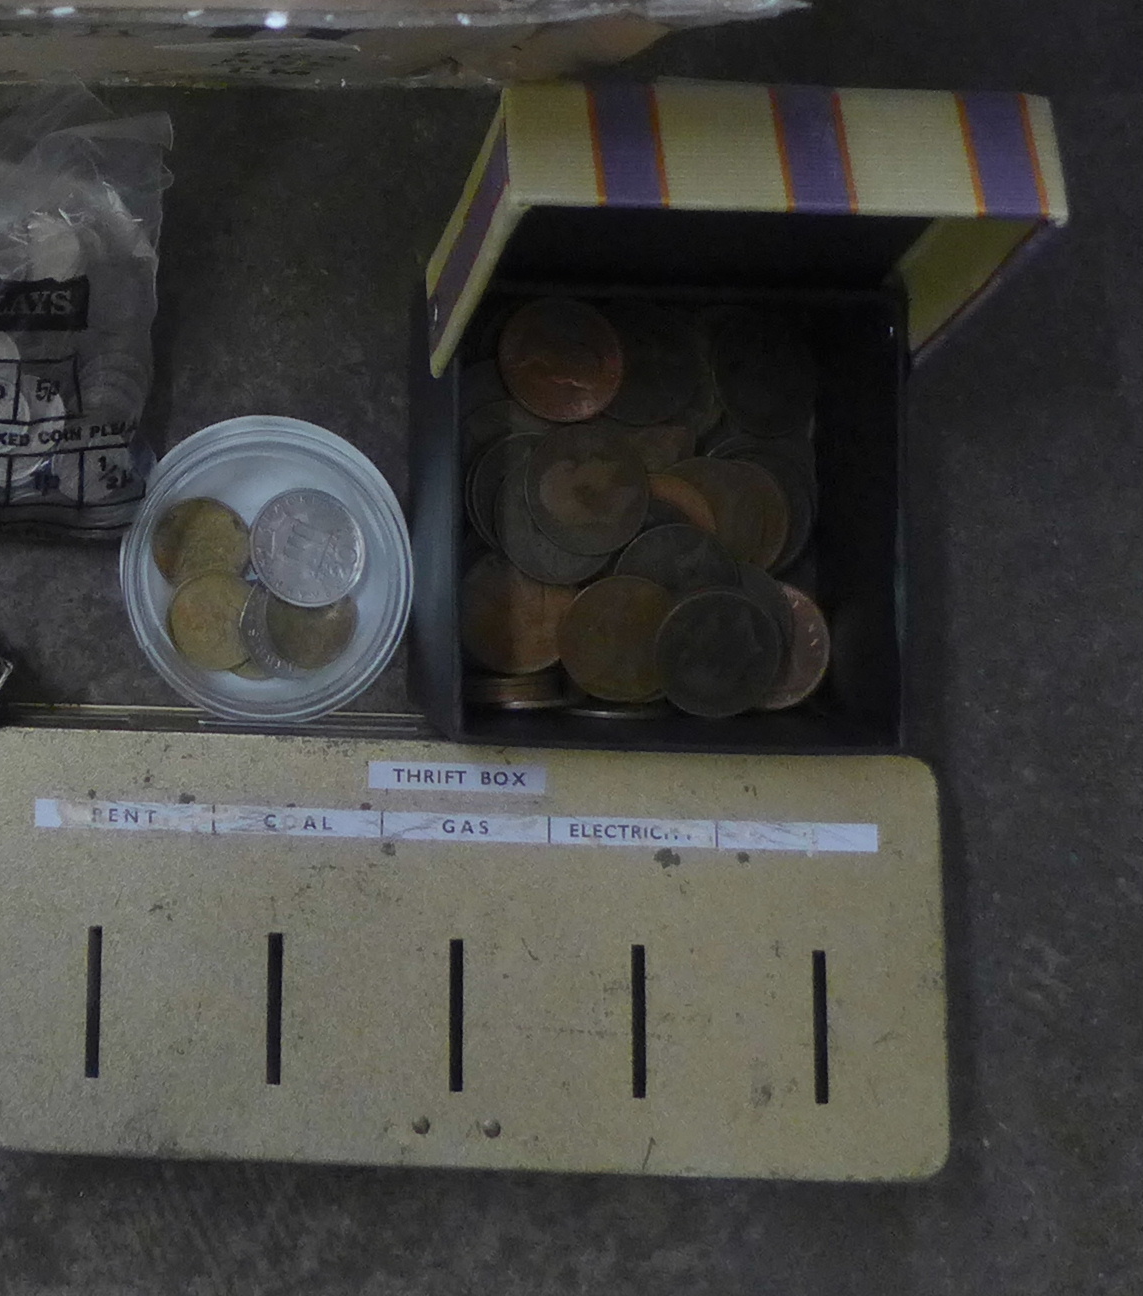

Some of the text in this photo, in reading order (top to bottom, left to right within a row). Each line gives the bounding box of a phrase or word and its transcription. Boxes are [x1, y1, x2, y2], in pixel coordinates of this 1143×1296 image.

[36, 376, 61, 401] 5p
[38, 426, 83, 445] COIN
[392, 768, 528, 788] THRIFT BOX
[441, 818, 491, 836] GAS
[568, 823, 693, 841] ELECTRIC
